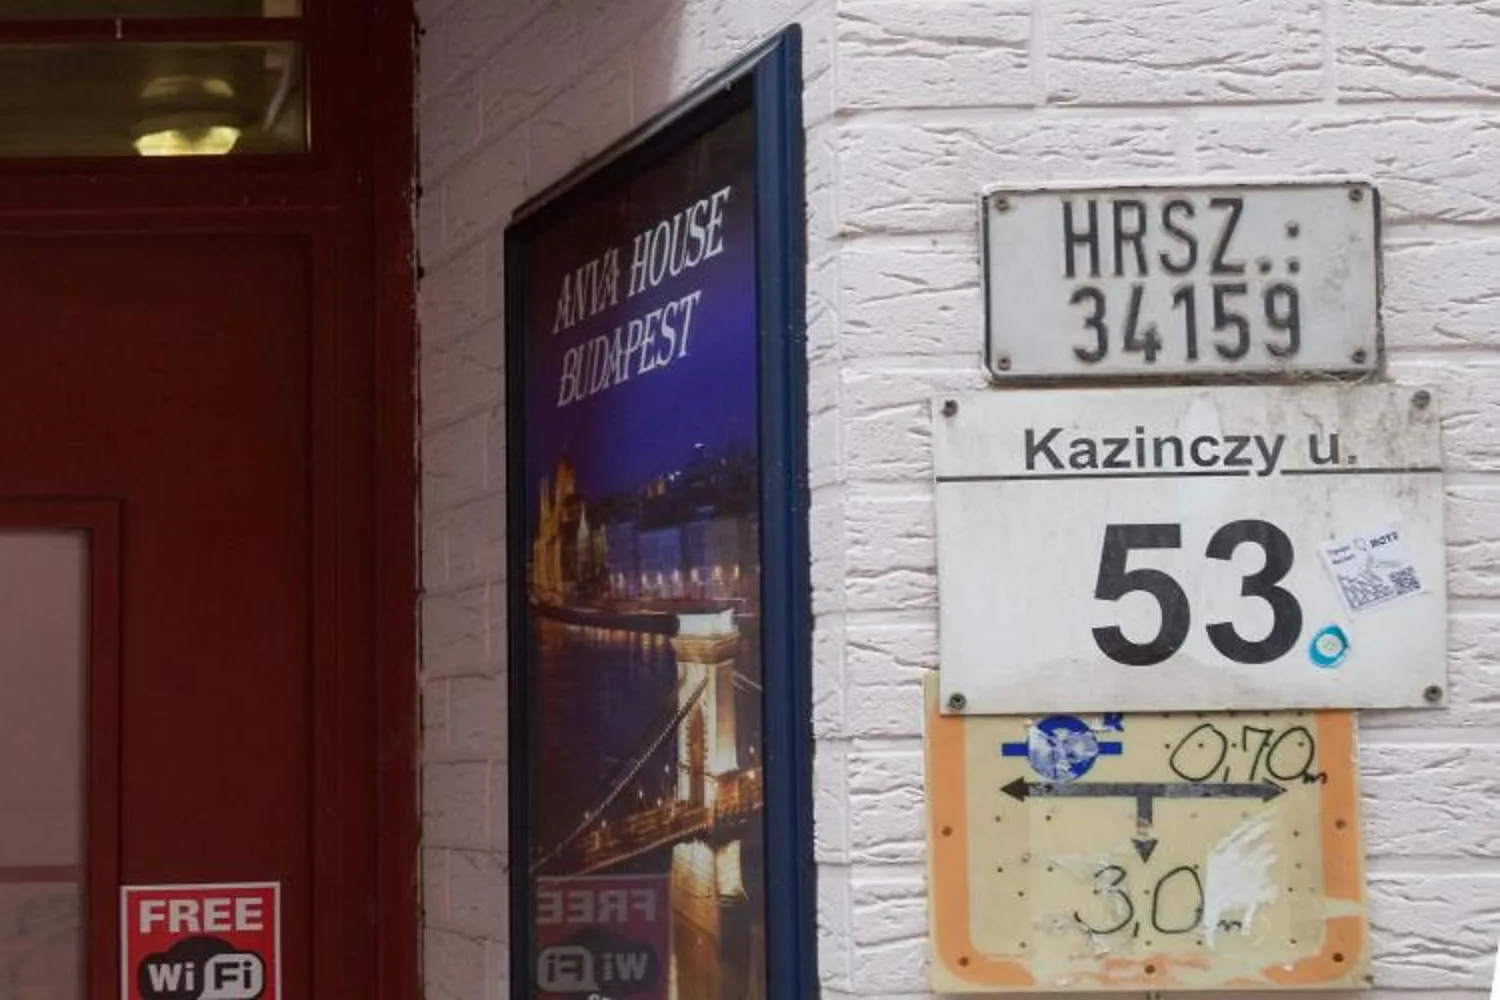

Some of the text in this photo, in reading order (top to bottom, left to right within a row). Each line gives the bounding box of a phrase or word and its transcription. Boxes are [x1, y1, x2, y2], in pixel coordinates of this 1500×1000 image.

[553, 185, 731, 335] ANVA HOUSE
[557, 289, 702, 407] BUDAPEST
[1068, 283, 1302, 365] 34159
[1024, 425, 1358, 477] Kazinczy u.
[1091, 518, 1304, 667] 53
[139, 896, 263, 933] FREE
